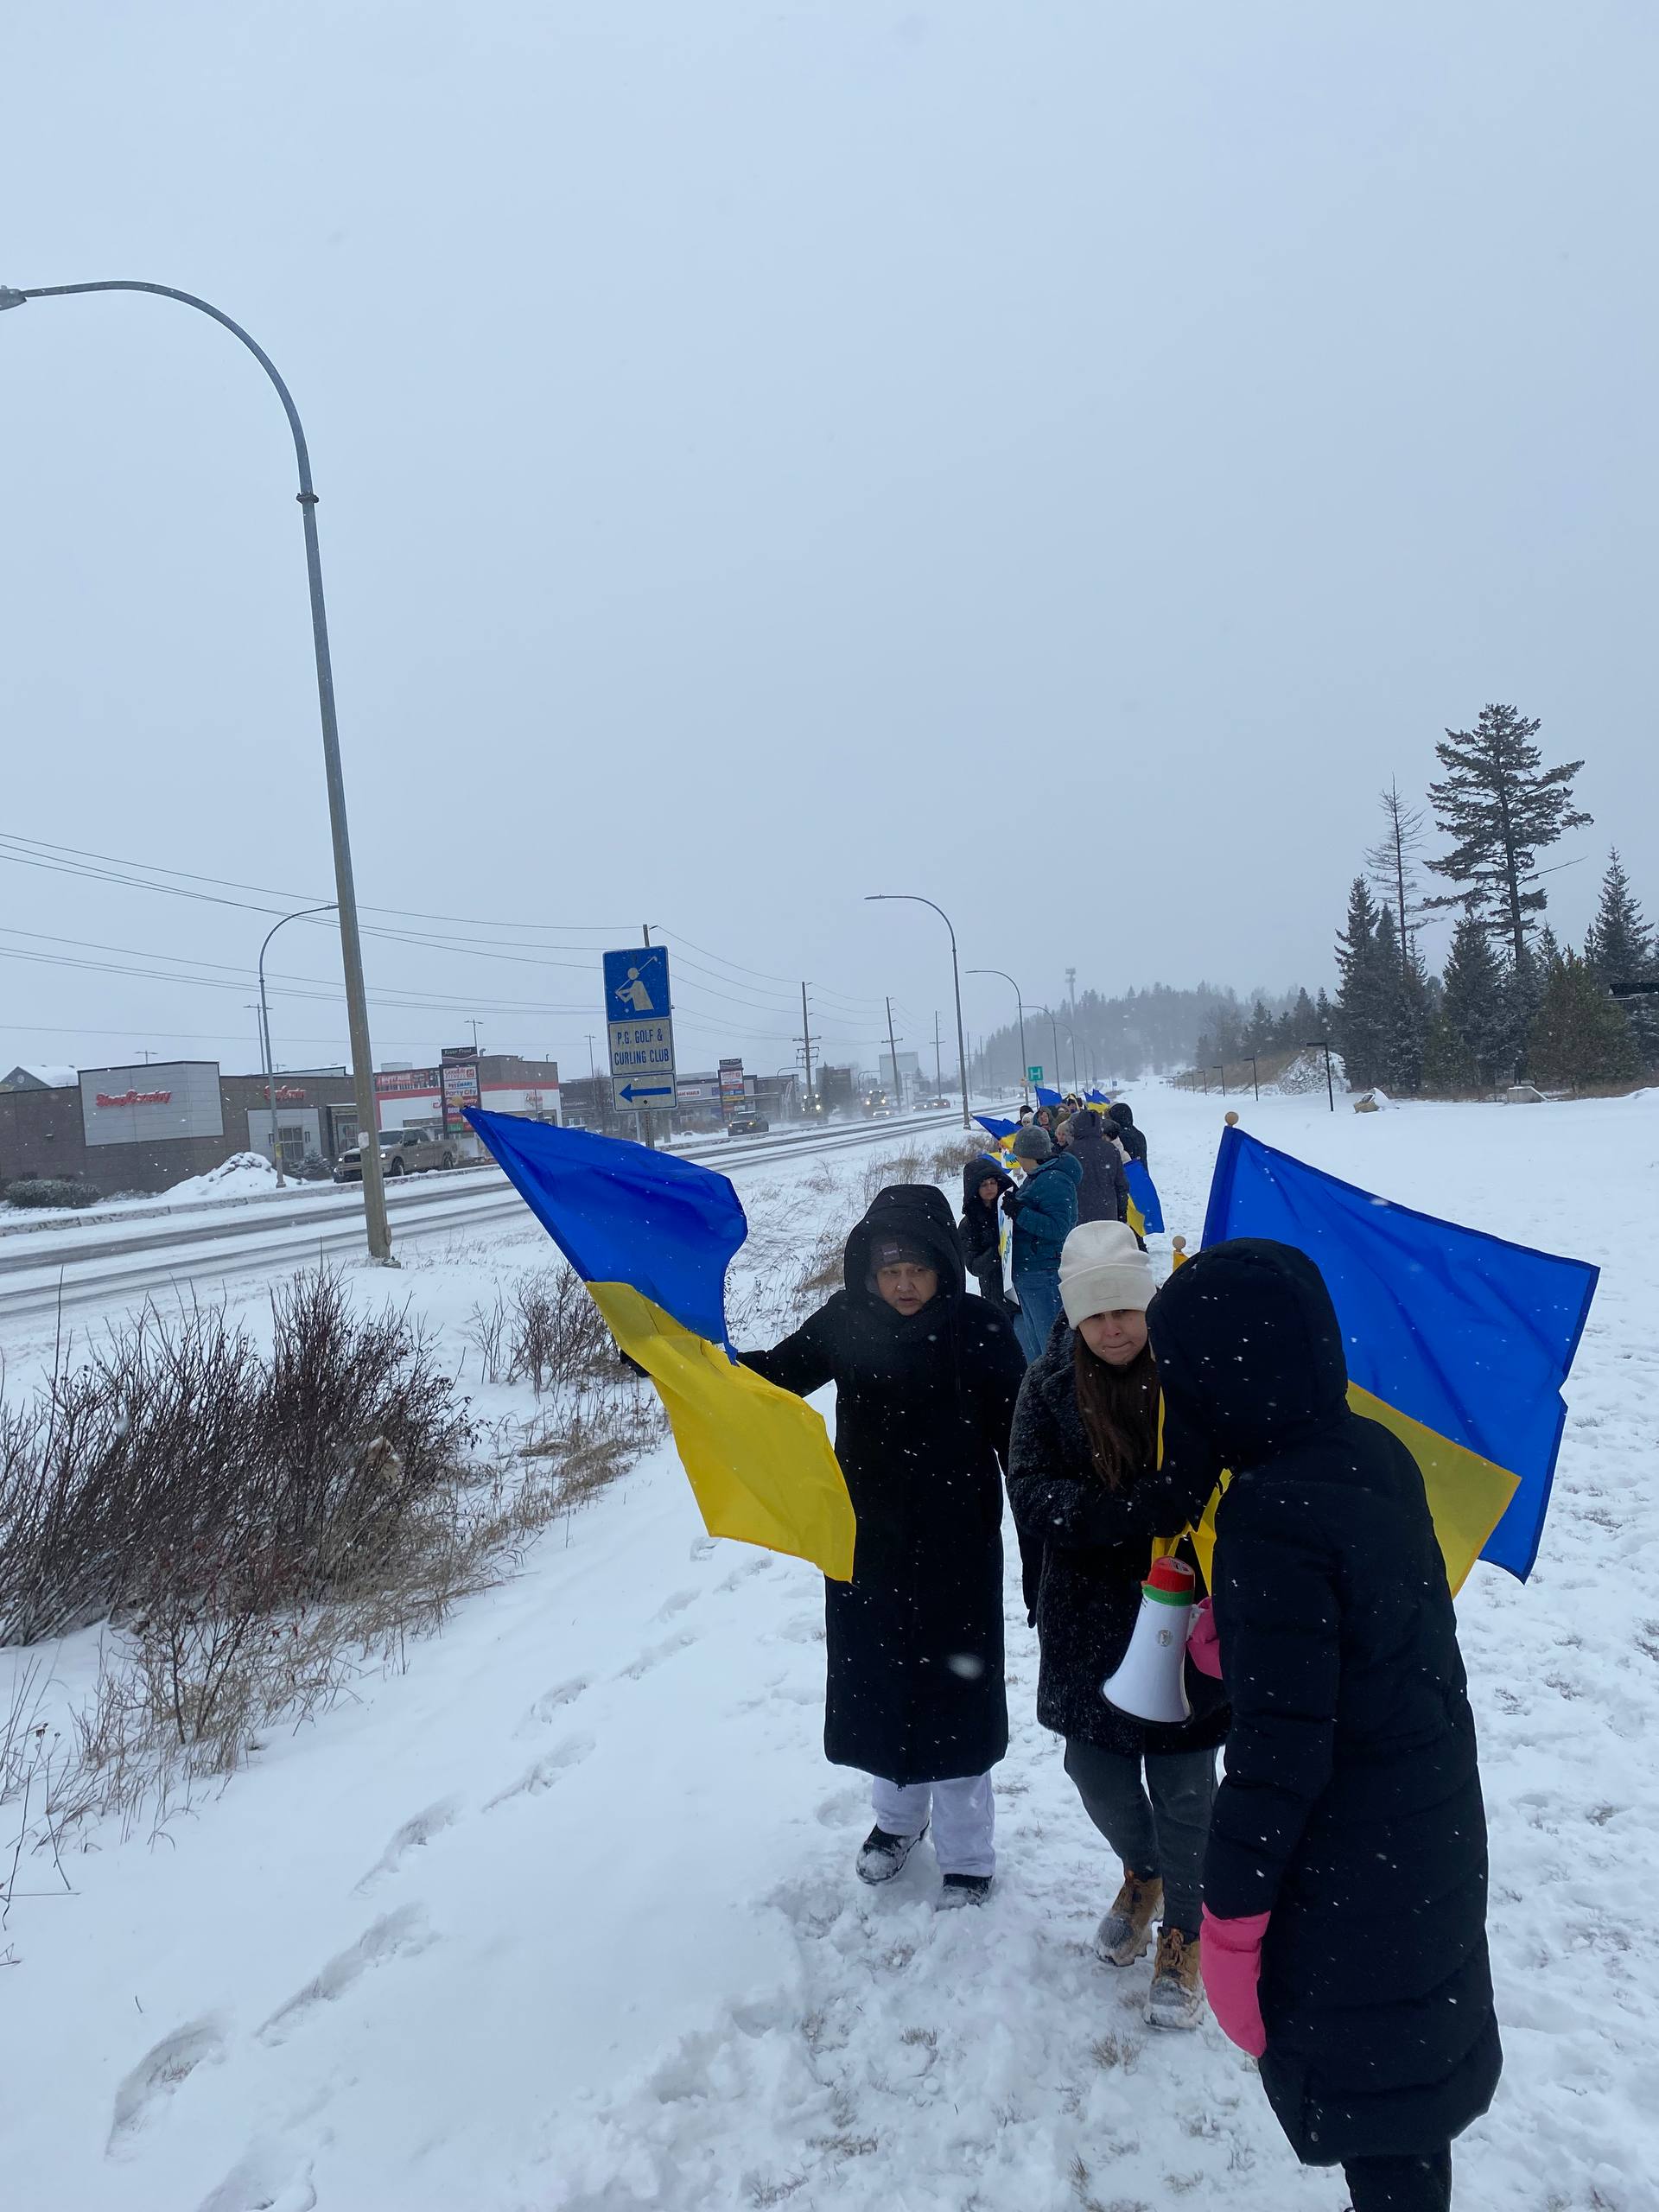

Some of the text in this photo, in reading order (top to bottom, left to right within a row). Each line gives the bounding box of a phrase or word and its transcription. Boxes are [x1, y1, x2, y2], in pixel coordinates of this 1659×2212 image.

[617, 1028, 663, 1044] P.G. GOLF &
[614, 1048, 669, 1065] CURLING CLUB
[1031, 1068, 1040, 1079] H
